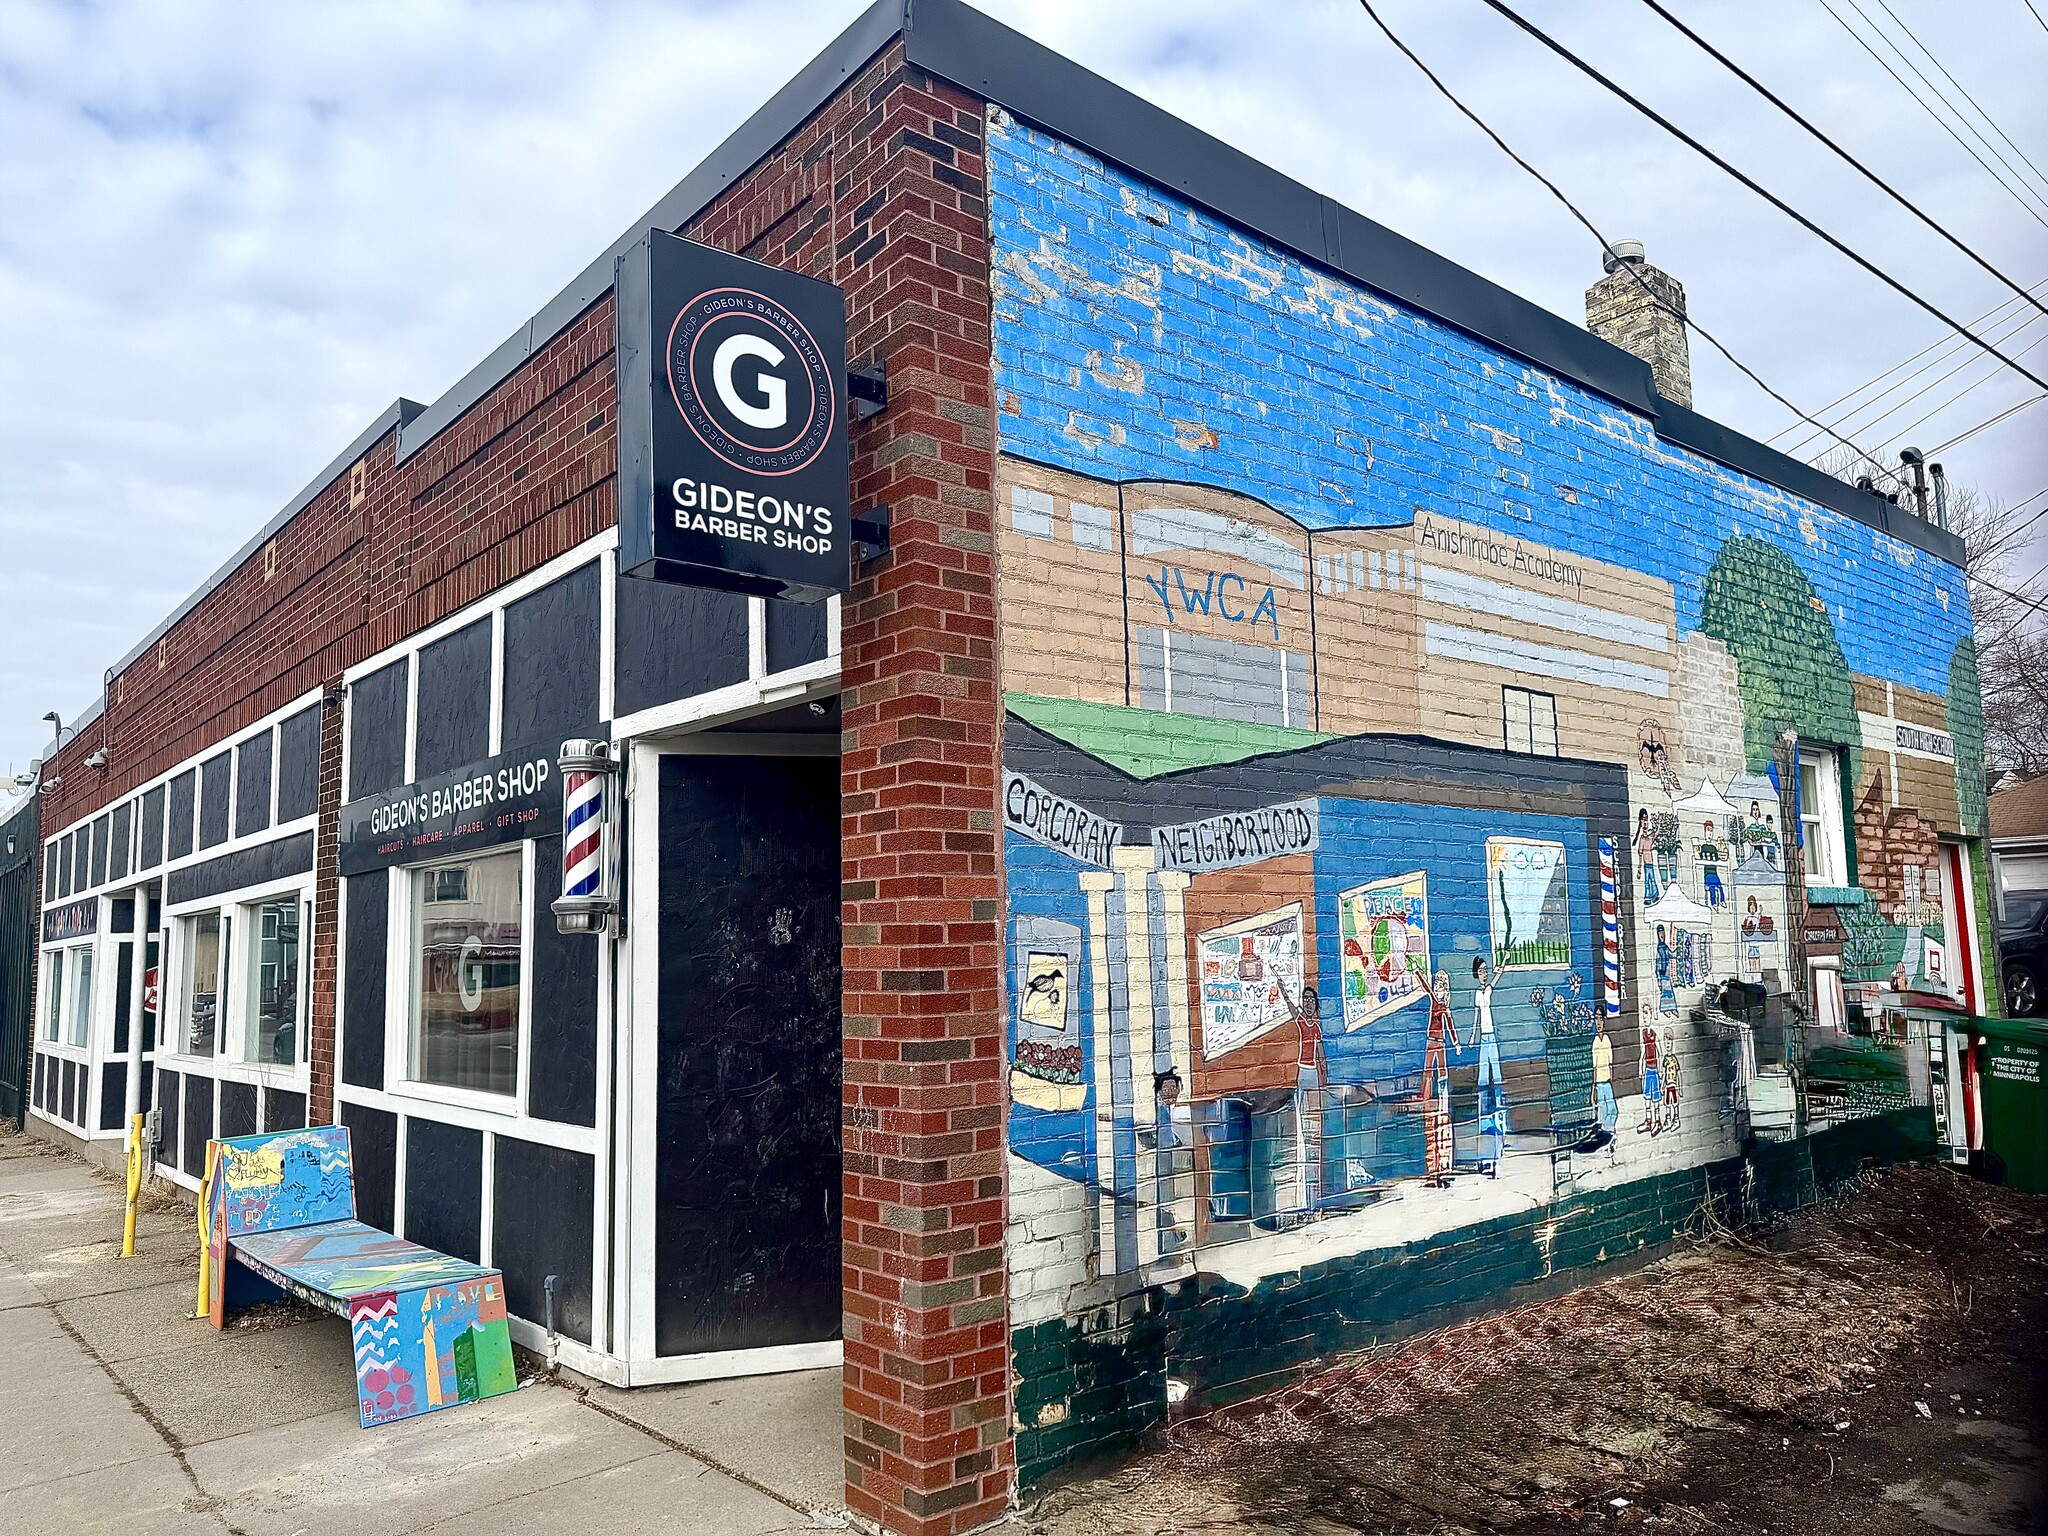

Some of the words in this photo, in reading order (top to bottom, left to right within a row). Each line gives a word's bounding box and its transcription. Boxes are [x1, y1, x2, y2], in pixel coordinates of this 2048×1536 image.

[679, 316, 697, 347] SHOP
[703, 297, 754, 314] GIDEON'S
[757, 303, 800, 339] BARBER
[799, 338, 821, 372] SHOP
[676, 349, 693, 401] BARBER
[712, 333, 787, 430] G
[689, 404, 735, 454] GIDEON'S
[812, 384, 828, 438] GIDEON'S
[746, 455, 778, 467] SHOP
[780, 437, 816, 465] BARBER
[672, 477, 833, 535] GIDEON'S
[675, 509, 768, 545] BARBER
[773, 529, 832, 555] SHOP
[1420, 516, 1508, 567] Anishinabe
[1512, 540, 1582, 602] Academy
[1146, 566, 1279, 641] YWCA
[1896, 727, 1919, 750] SOUTH
[1920, 731, 1933, 752] HIGH
[371, 793, 429, 835] GIDEON'S
[432, 774, 494, 819] BARBER
[497, 758, 549, 802] SHOP
[377, 839, 404, 855] HAIRCUTS
[412, 830, 443, 847] HAIRCARE
[453, 820, 485, 837] APPAREL
[496, 813, 514, 828] GIFT
[517, 807, 540, 823] SHOP
[1005, 778, 1117, 871] CORCORAN
[1159, 807, 1312, 869] NEIGHBORHOOD
[1363, 895, 1413, 923] PEACE
[457, 934, 483, 1012] G
[1992, 1070, 2040, 1083] MINNEAPOLIS
[1996, 1063, 2010, 1072] THE
[2010, 1065, 2026, 1073] CITY
[2026, 1067, 2037, 1075] OF
[2028, 1060, 2040, 1068] OF
